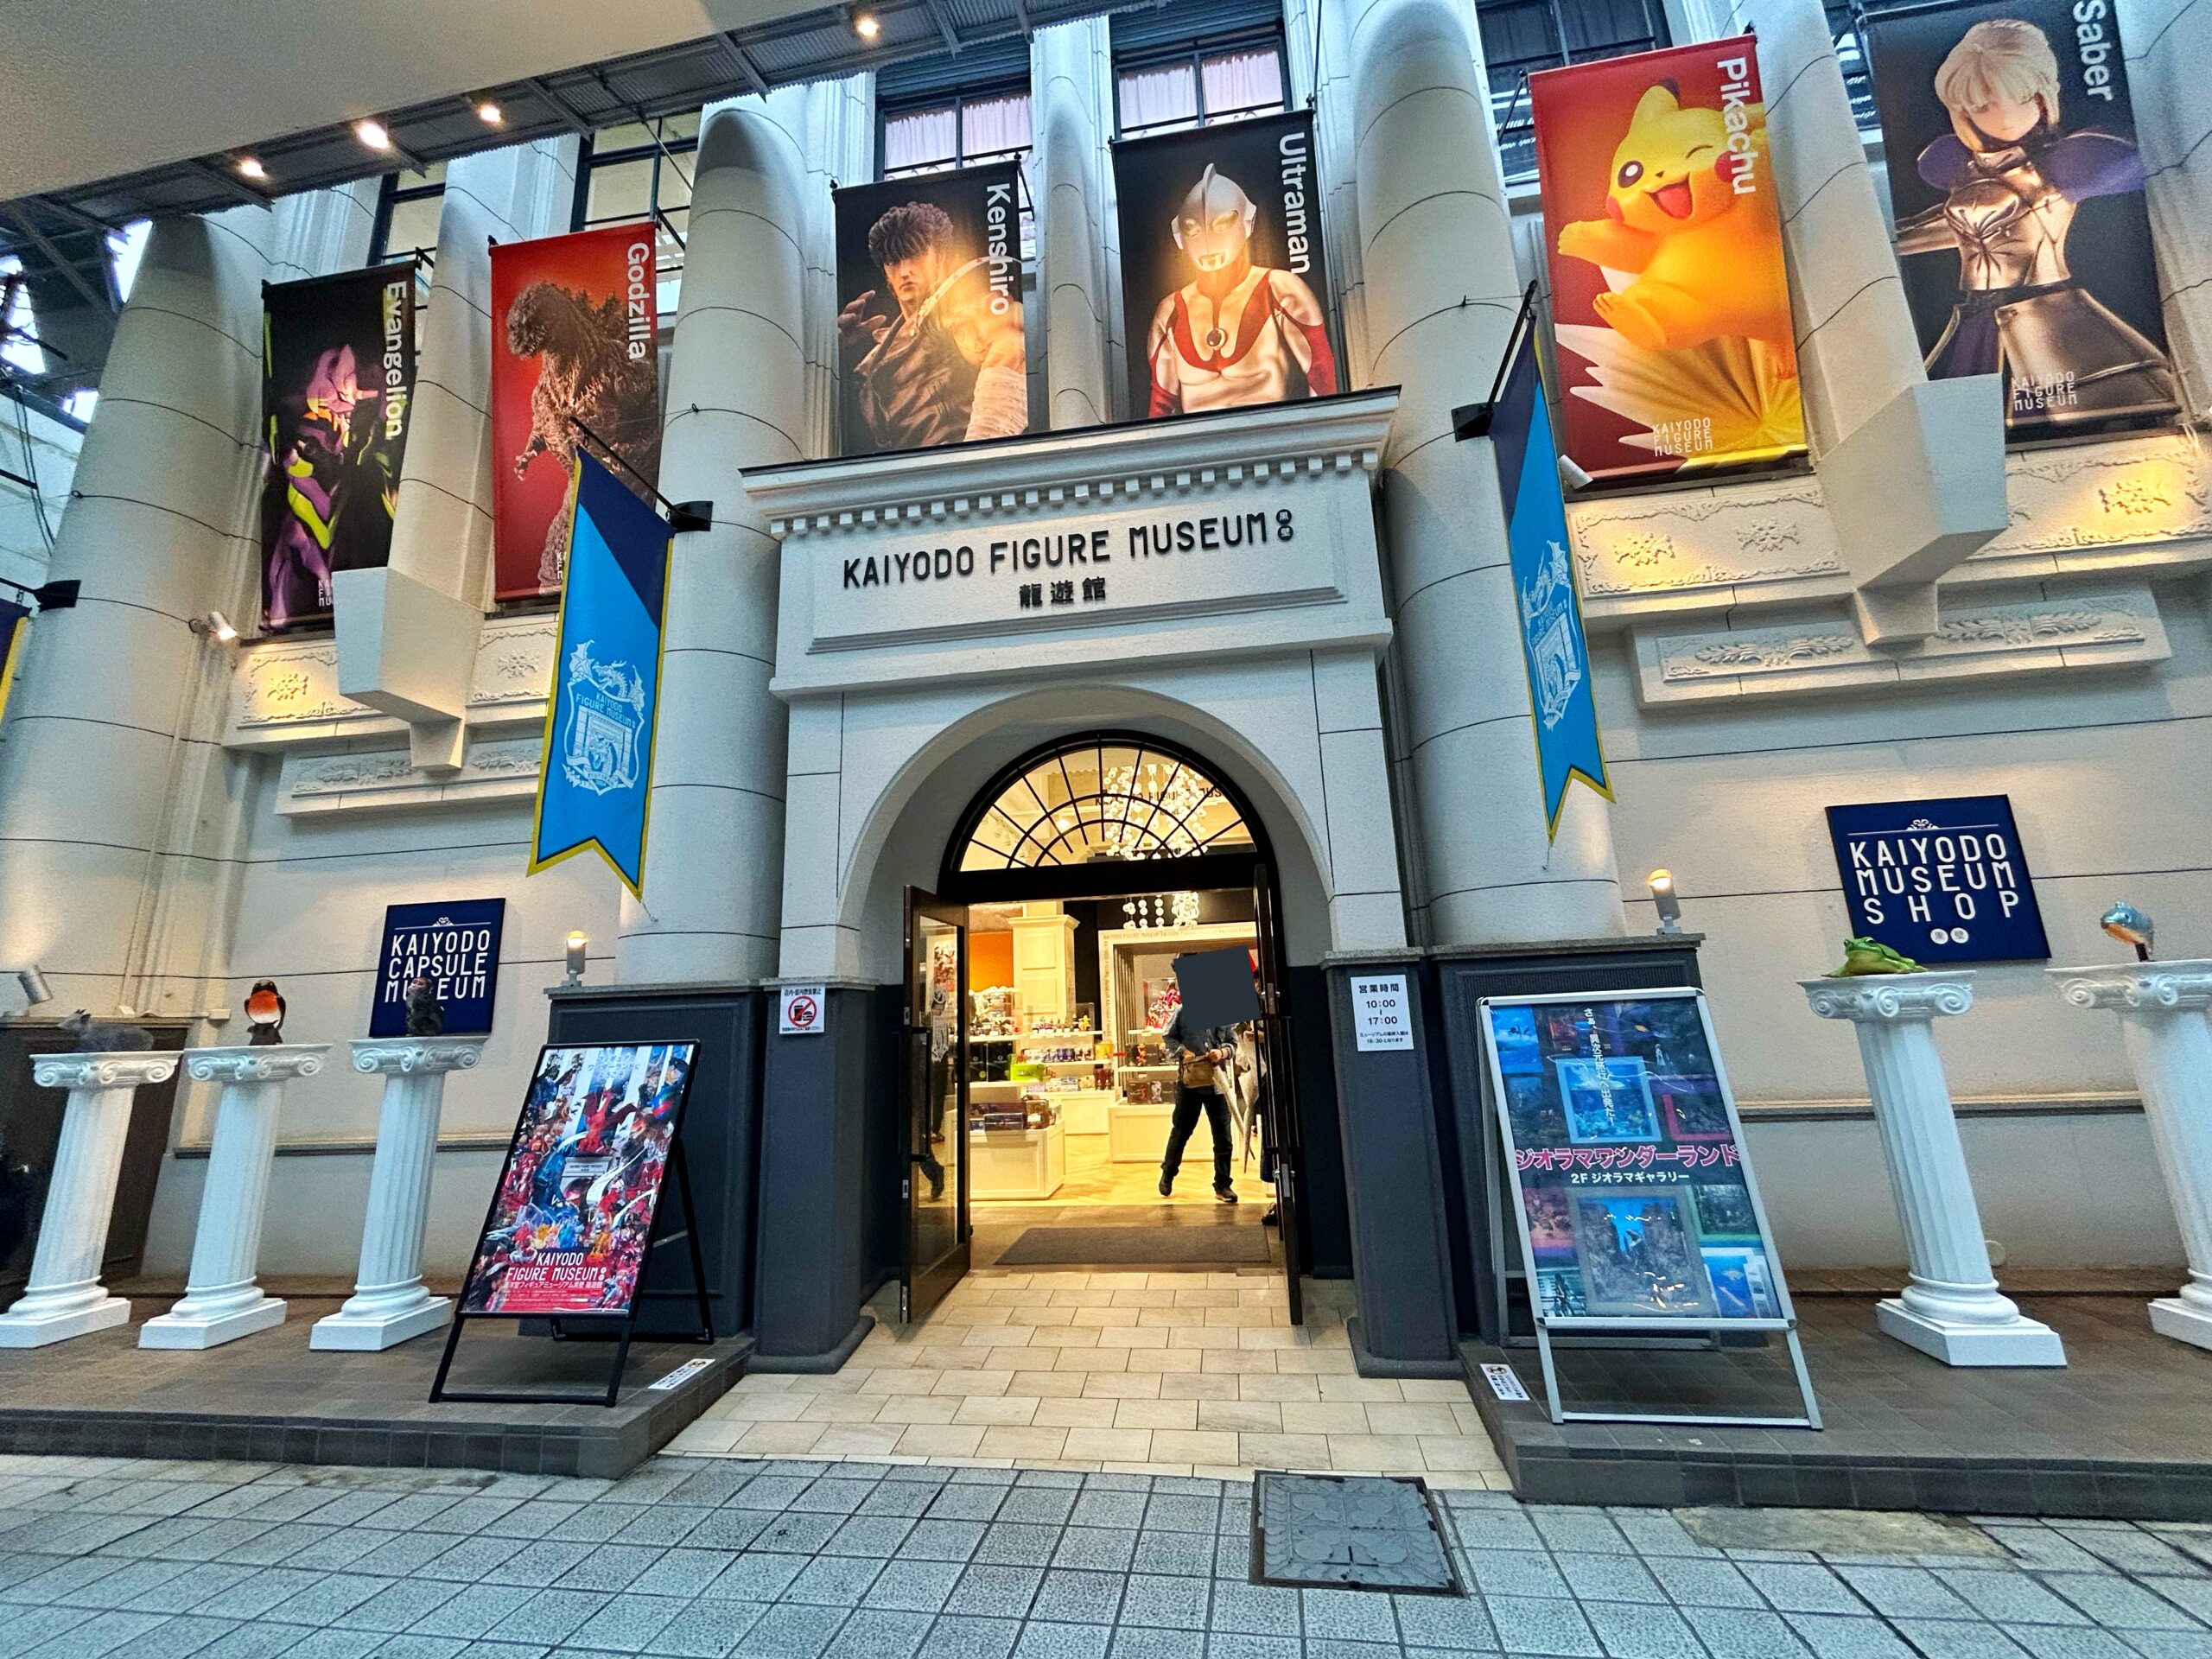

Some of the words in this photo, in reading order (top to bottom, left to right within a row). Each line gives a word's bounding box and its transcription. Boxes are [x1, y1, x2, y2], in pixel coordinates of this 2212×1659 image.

[2070, 0, 2113, 100] Saber
[1716, 56, 1757, 194] Pikachu
[1278, 131, 1311, 275] Ultraman
[986, 182, 1014, 316] Kenshiro
[626, 242, 650, 360] Godzilla
[383, 280, 408, 440] Evangelion
[2013, 382, 2076, 400] FIGURE
[2014, 393, 2077, 411] MUSEUM
[1652, 416, 1711, 435] KAIYODO
[1654, 428, 1712, 445] FIGURE
[1655, 439, 1713, 457] MUSEUM
[843, 546, 975, 588] KAIYODO
[989, 530, 1111, 574] FIGURE
[1129, 512, 1268, 557] MUSEUM
[1019, 575, 1106, 608] 龍遊館
[575, 693, 607, 714] FIGURE
[606, 707, 632, 727] MUSEUM
[595, 693, 623, 714] KAIYODO
[1849, 833, 2007, 868] KAIYODO
[1855, 861, 2017, 896] MUSEUM
[1863, 890, 2019, 925] SHOP
[391, 929, 491, 957] KAIYODO
[388, 952, 488, 980] CAPSULE
[385, 976, 486, 1003] MEUM
[1358, 982, 1400, 994] 営業時間
[1366, 999, 1396, 1008] 10:00
[1368, 1015, 1398, 1026] 17:00
[1515, 1143, 1742, 1170] ジオラマワンダーランド
[1570, 1173, 1588, 1184] 2F
[1592, 1171, 1690, 1184] ジオラマギャラリー
[536, 1252, 585, 1266] KAIYODO
[505, 1267, 550, 1281] FIGURE
[551, 1267, 599, 1281] MUSEUM
